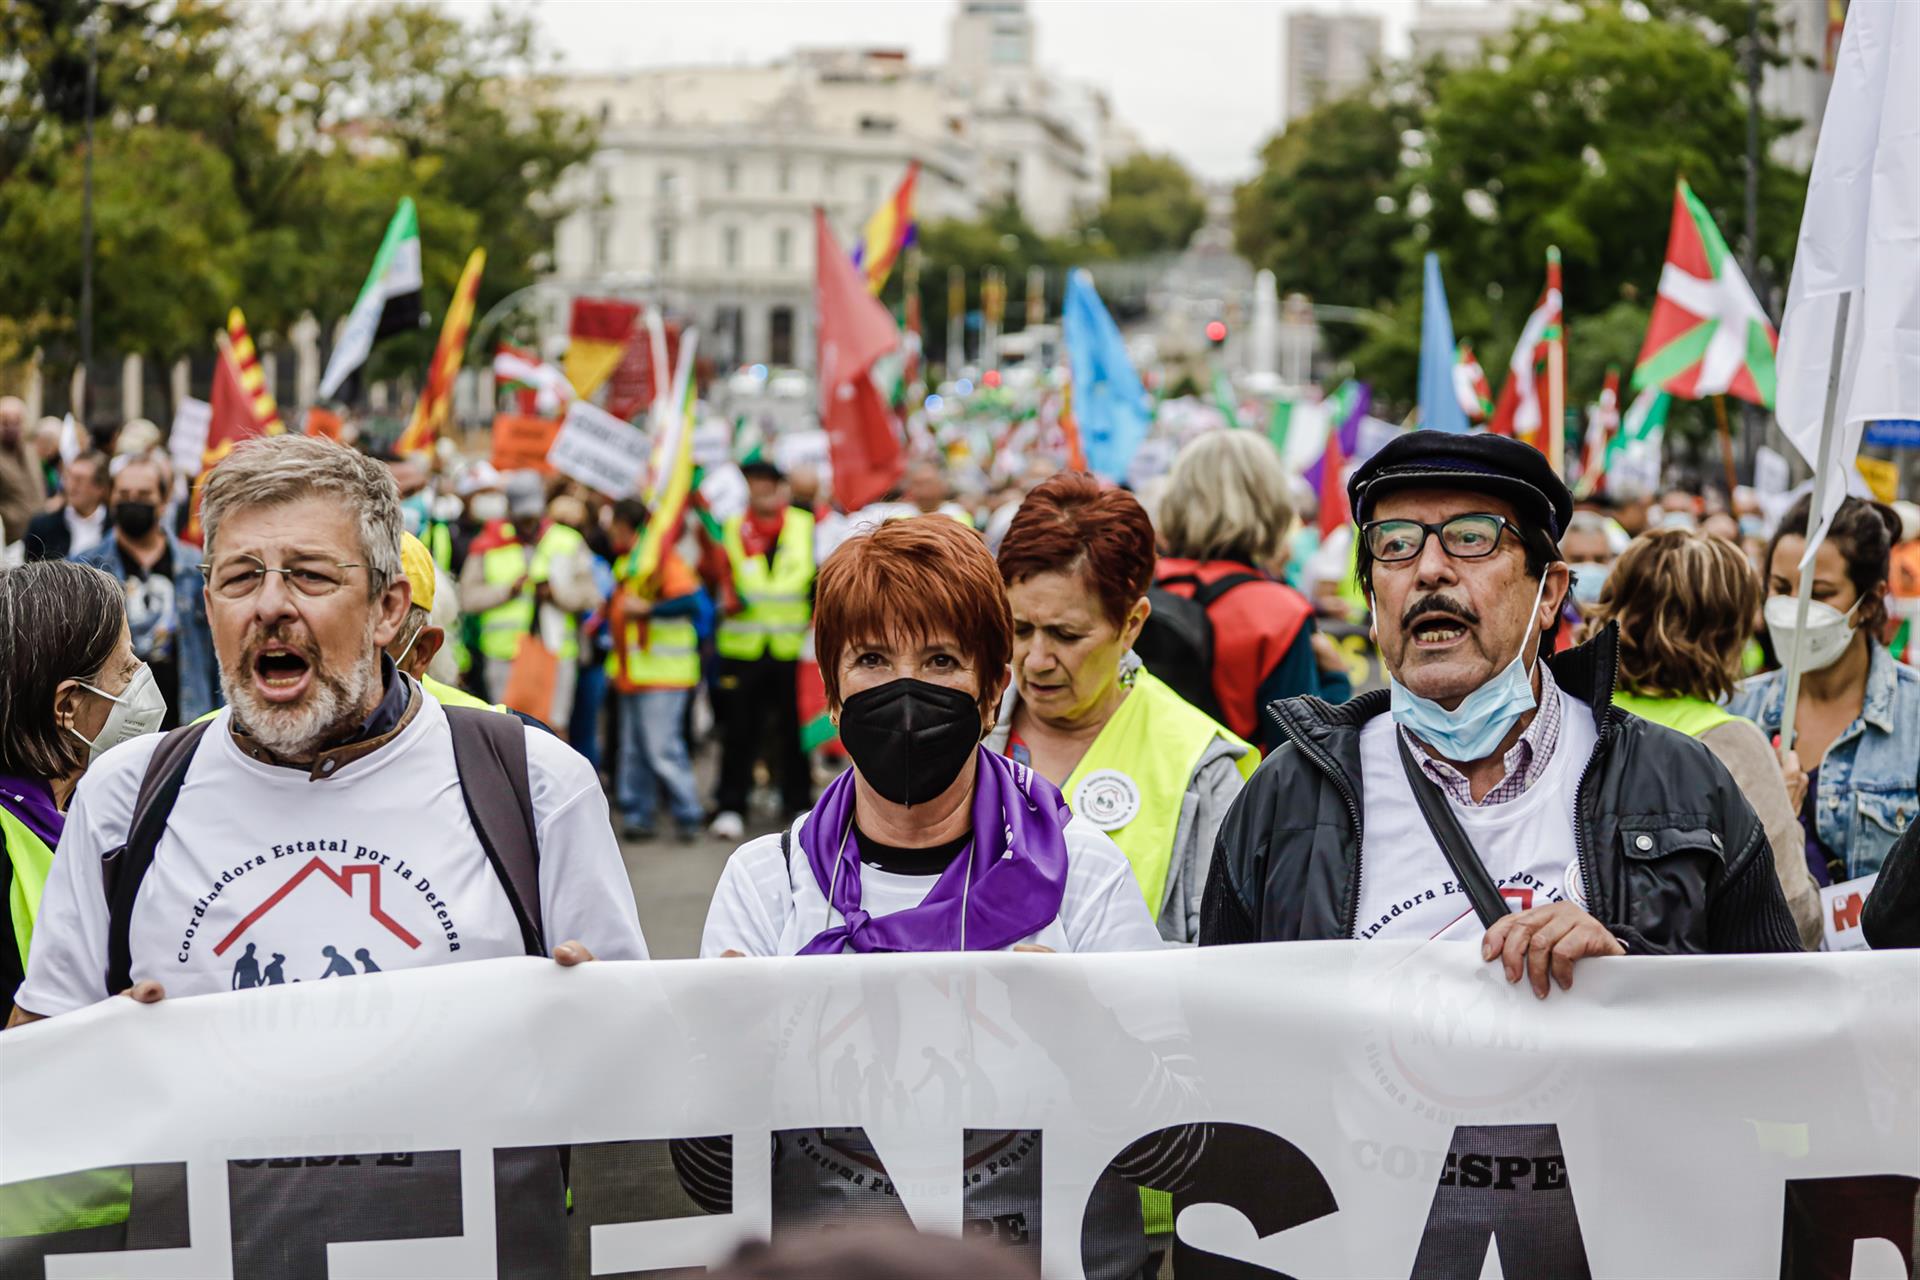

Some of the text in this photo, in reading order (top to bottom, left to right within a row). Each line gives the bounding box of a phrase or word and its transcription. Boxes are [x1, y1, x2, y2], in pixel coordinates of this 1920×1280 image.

[178, 839, 461, 963] Coordinadora Estatal por la Defensa
[1355, 887, 1436, 940] inadora
[1509, 871, 1544, 892] por
